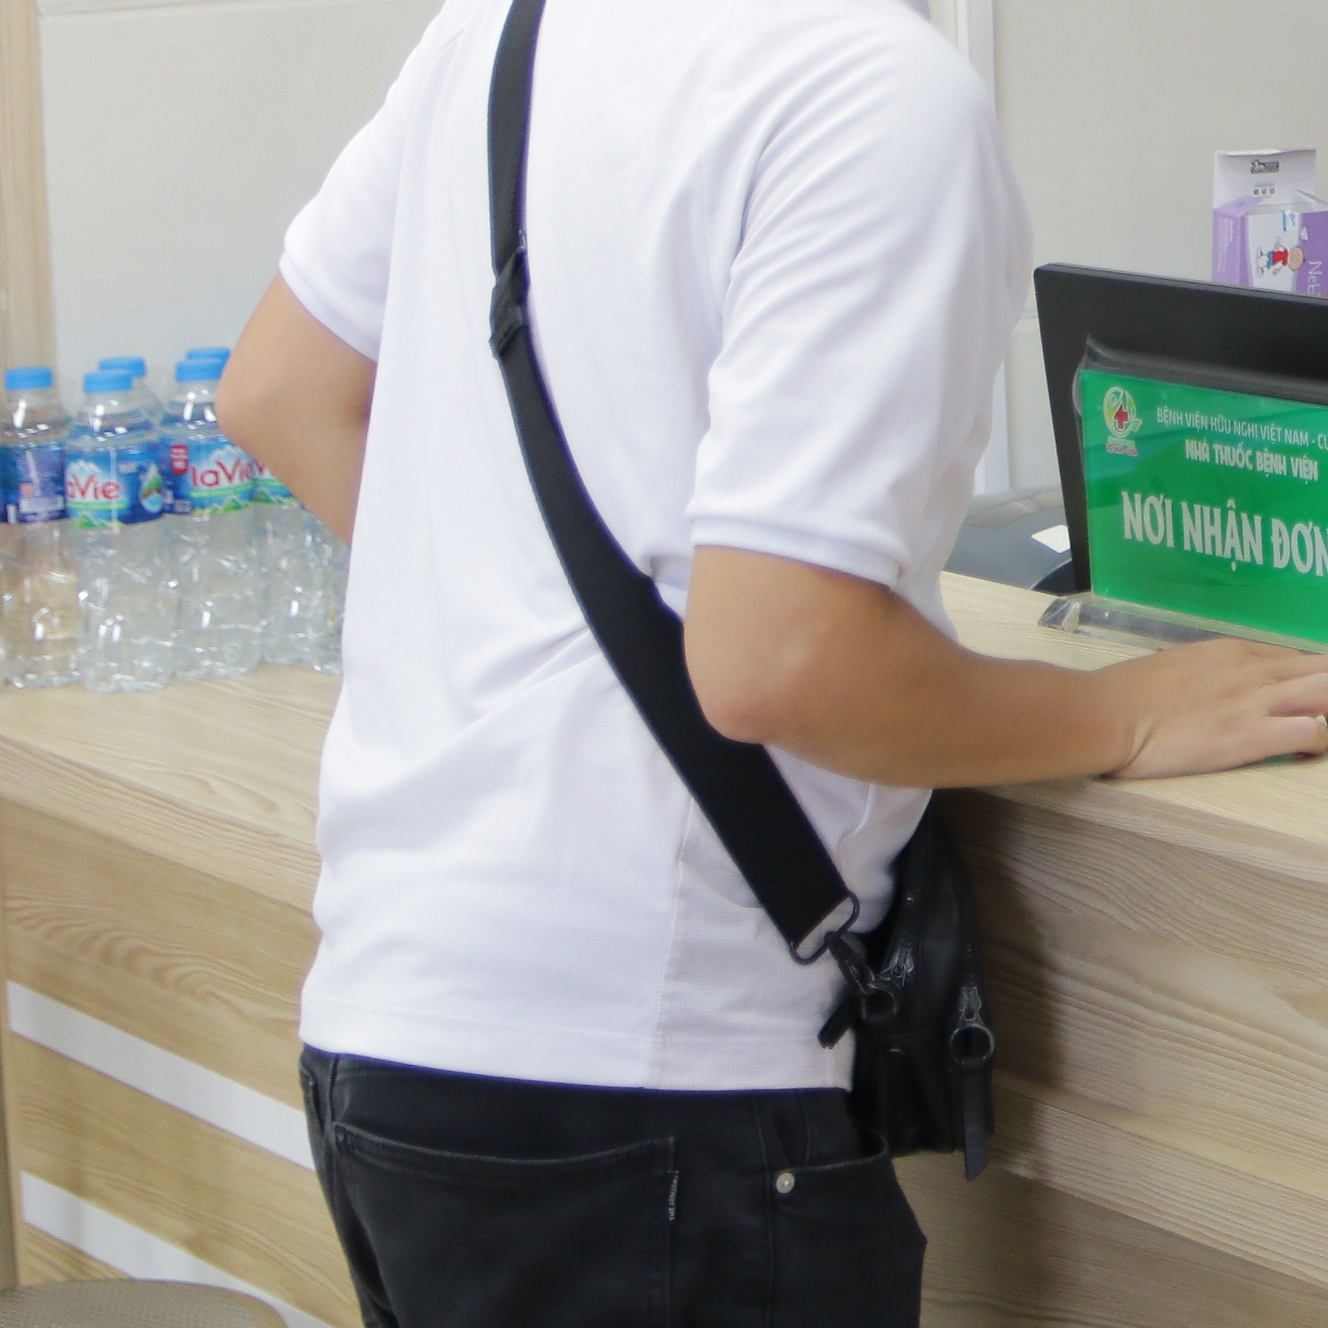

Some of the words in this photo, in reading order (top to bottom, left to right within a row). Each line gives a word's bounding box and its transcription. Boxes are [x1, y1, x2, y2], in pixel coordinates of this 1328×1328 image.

[1307, 260, 1324, 296] Neb
[1156, 407, 1184, 428] BỆNH
[1185, 410, 1210, 432] VIỆN
[1210, 414, 1232, 434] HỮU
[1233, 418, 1259, 442] NGHỊ
[1260, 421, 1282, 443] VIỆT
[1284, 429, 1309, 448] NAM
[1184, 437, 1211, 462] NHÀ
[1213, 441, 1254, 469] THUỐC
[1255, 448, 1288, 479] BỆNH
[1290, 456, 1320, 485] VIỆN
[1120, 490, 1176, 549] NƠI
[1180, 499, 1265, 572] NHẬN
